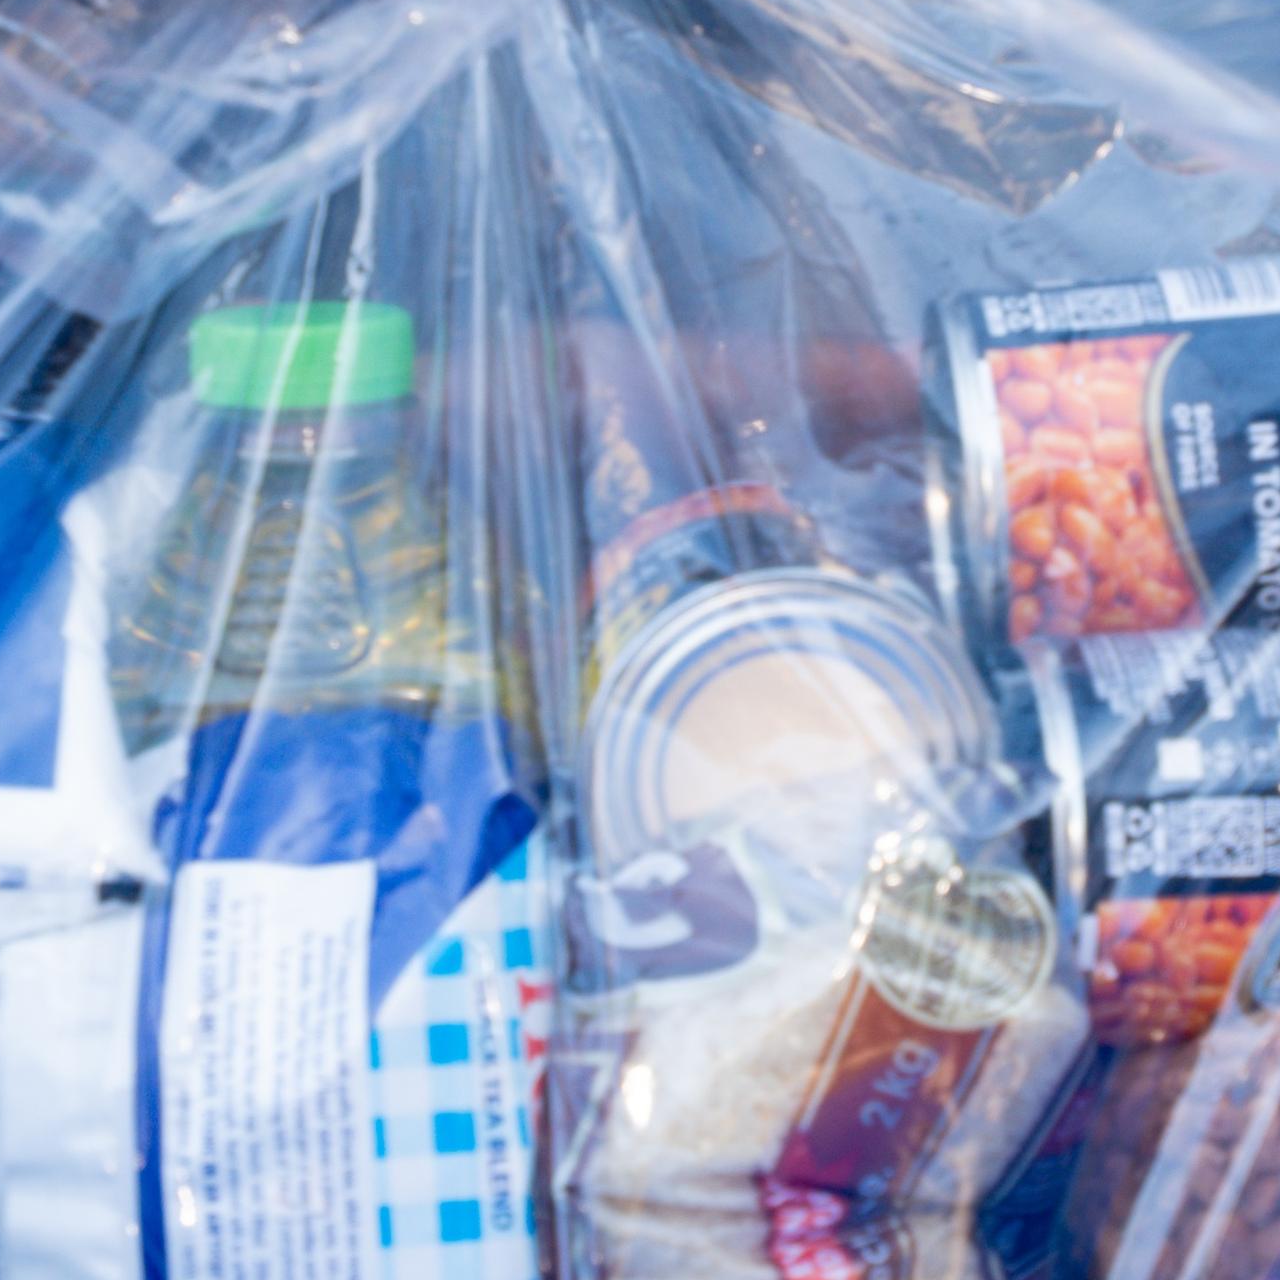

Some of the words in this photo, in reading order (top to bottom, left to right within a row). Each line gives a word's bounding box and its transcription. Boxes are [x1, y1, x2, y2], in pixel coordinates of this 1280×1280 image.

[1248, 421, 1277, 460] IN
[877, 1040, 939, 1099] kg
[481, 1079, 505, 1133] TEA
[860, 1101, 901, 1132] 2
[485, 1139, 513, 1233] BLEND
